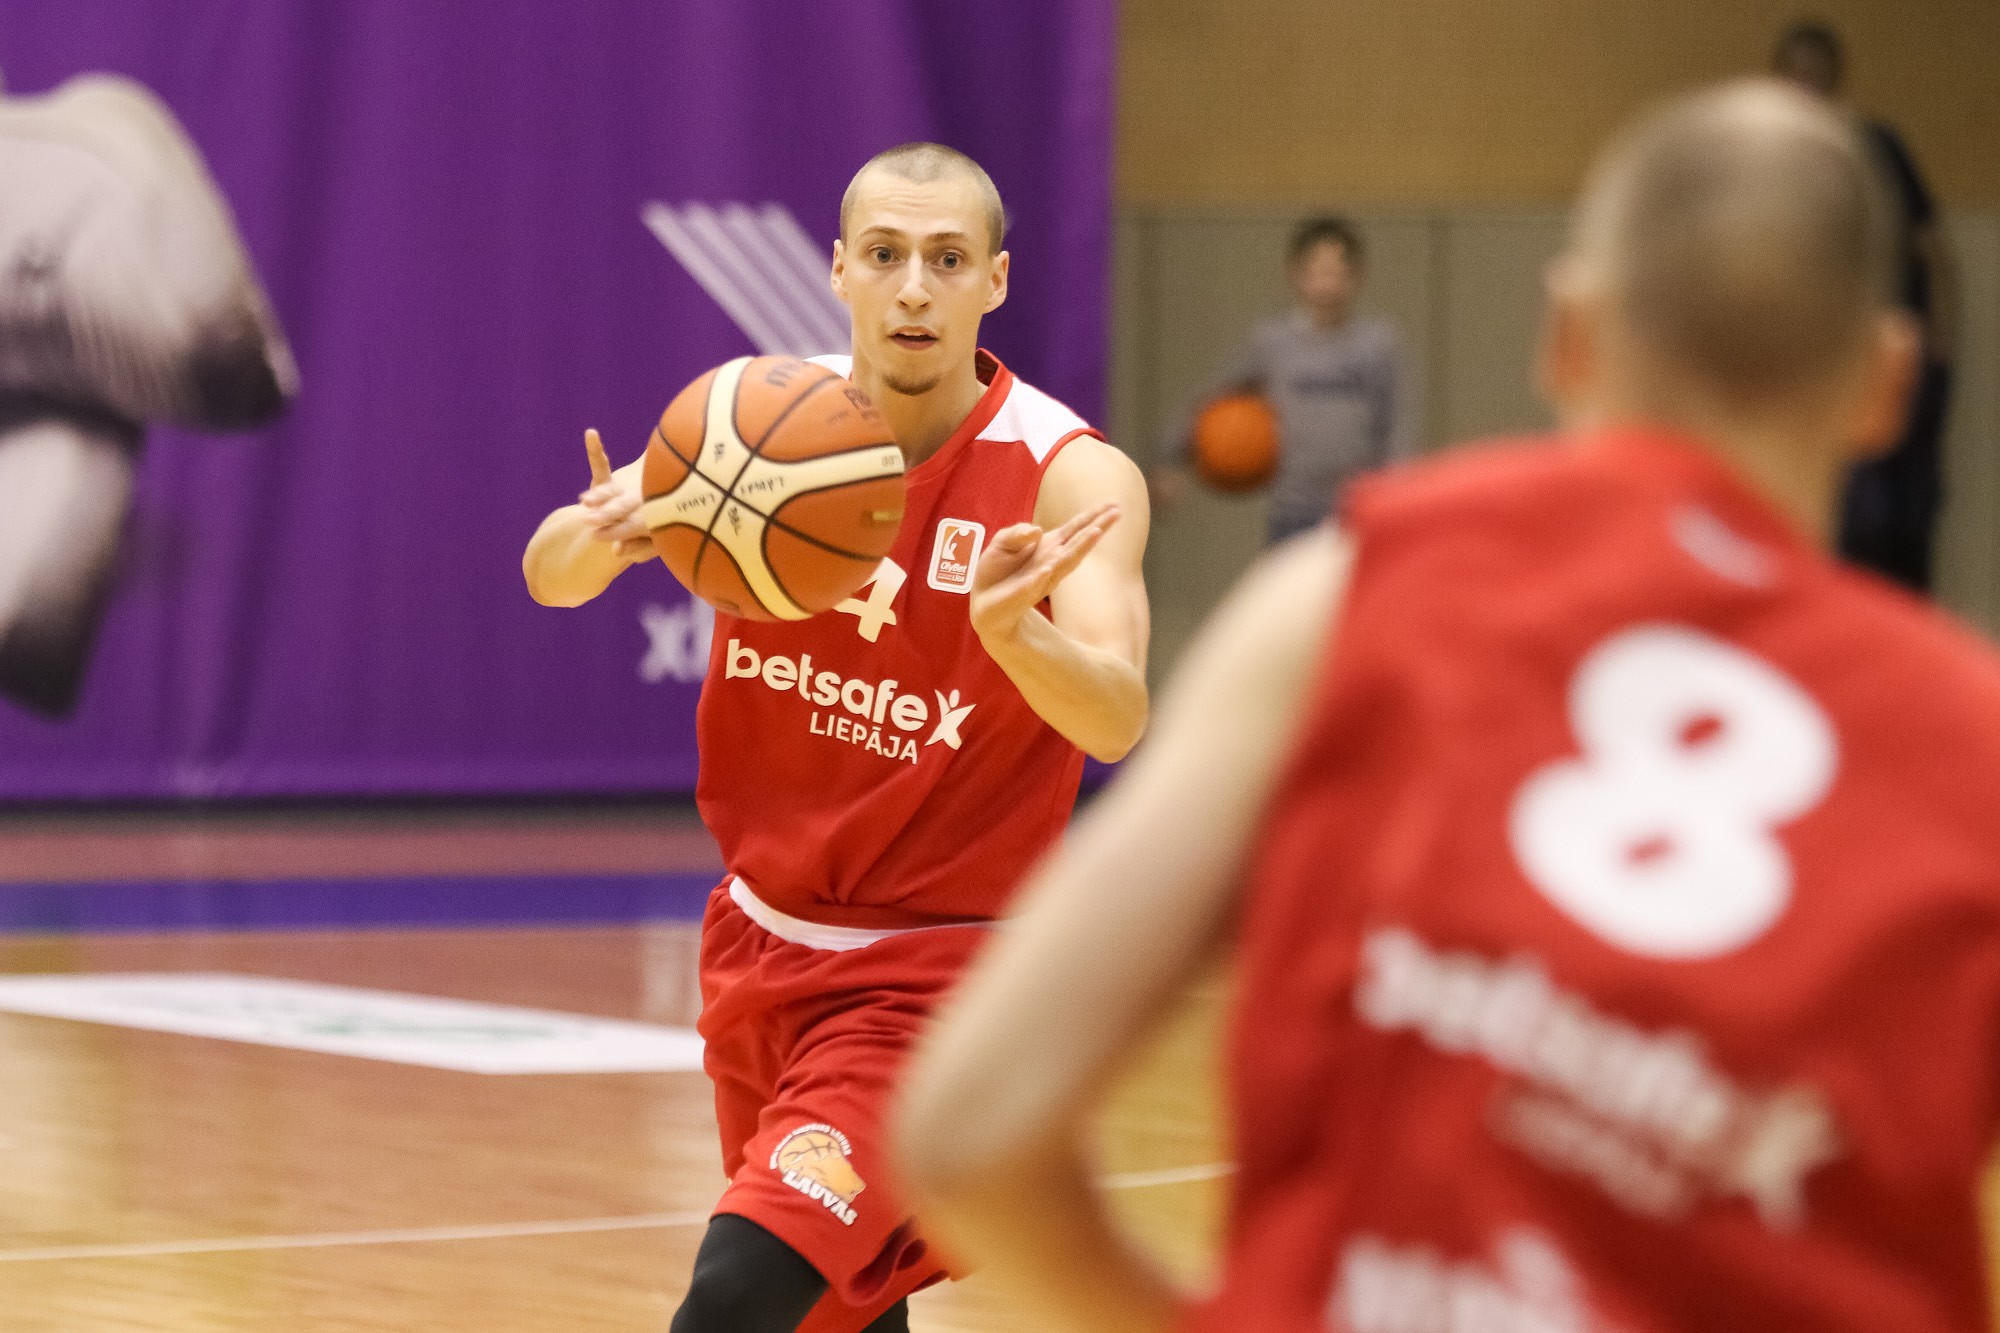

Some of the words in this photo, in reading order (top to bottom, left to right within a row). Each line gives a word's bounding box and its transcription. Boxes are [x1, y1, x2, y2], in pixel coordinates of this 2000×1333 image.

[725, 638, 929, 732] betsafe
[809, 711, 918, 765] LIEPĀJA
[1510, 626, 1838, 958] 8
[782, 1169, 858, 1227] LAUVAS
